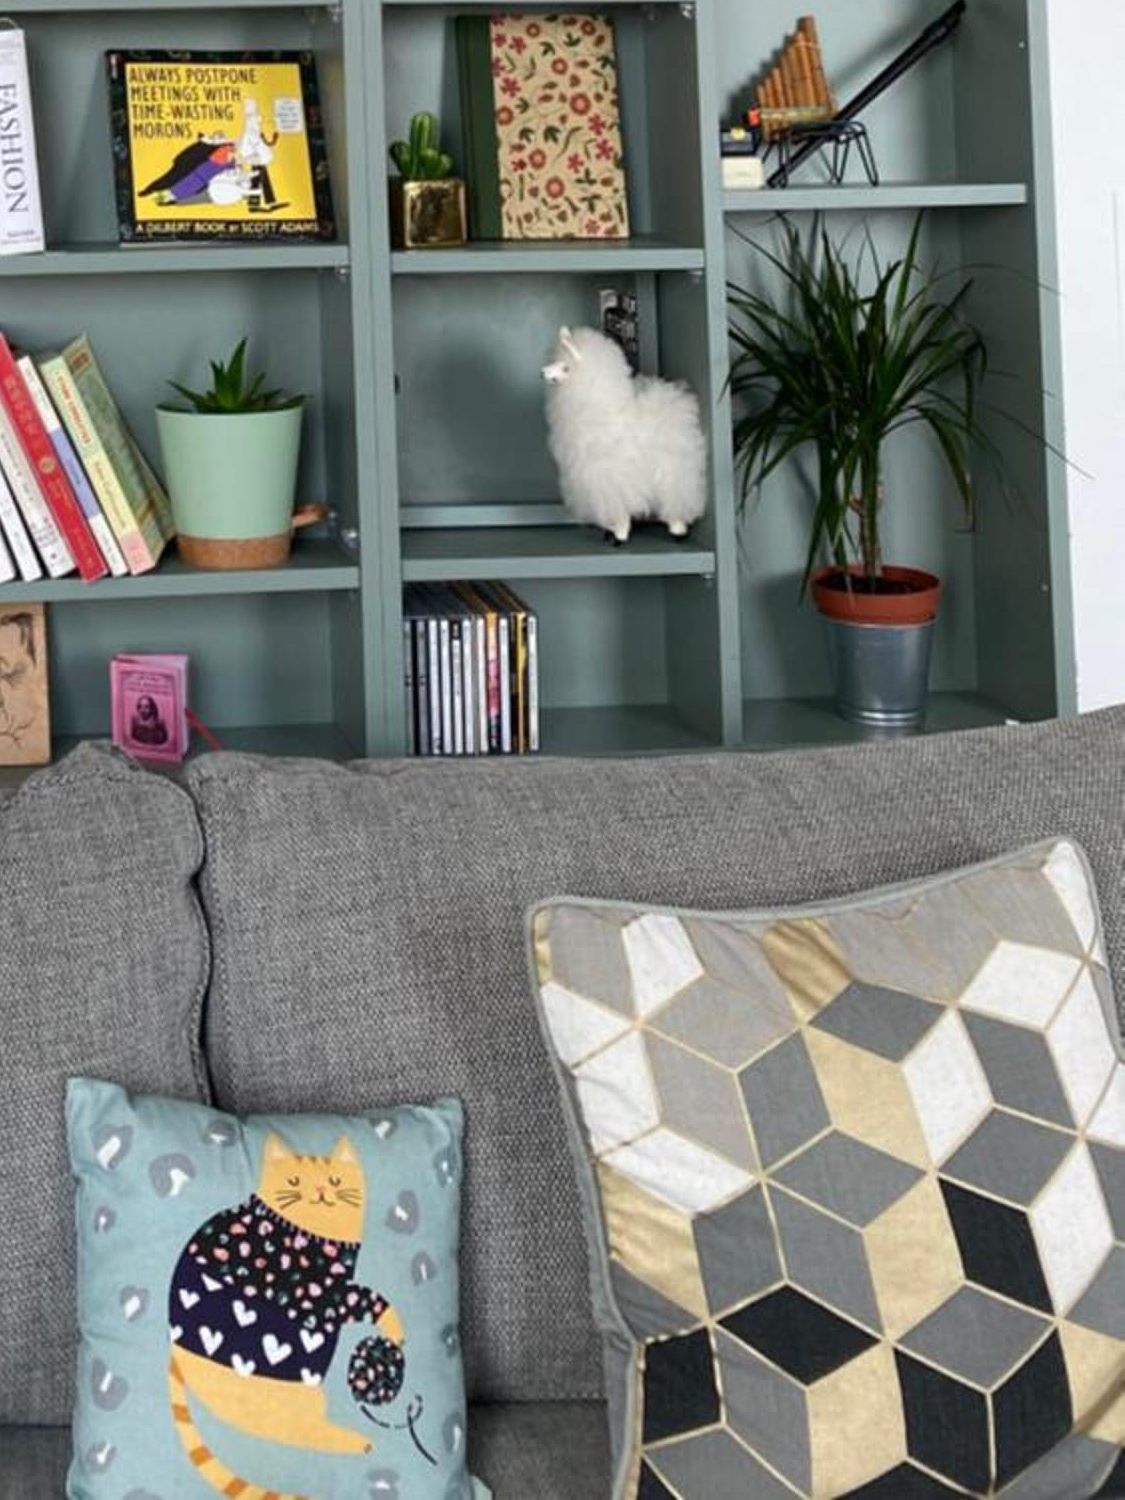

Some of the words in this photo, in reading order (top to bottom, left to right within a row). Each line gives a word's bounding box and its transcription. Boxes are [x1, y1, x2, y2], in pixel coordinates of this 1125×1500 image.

[130, 68, 181, 84] ALWAYS
[186, 67, 257, 84] POSTPONE
[131, 85, 199, 101] MEETINGS
[203, 85, 241, 100] WITH
[132, 104, 234, 121] TIME-WASTING
[133, 122, 192, 139] MORONS
[194, 223, 225, 233] BOOK
[241, 223, 276, 233] SCOTT
